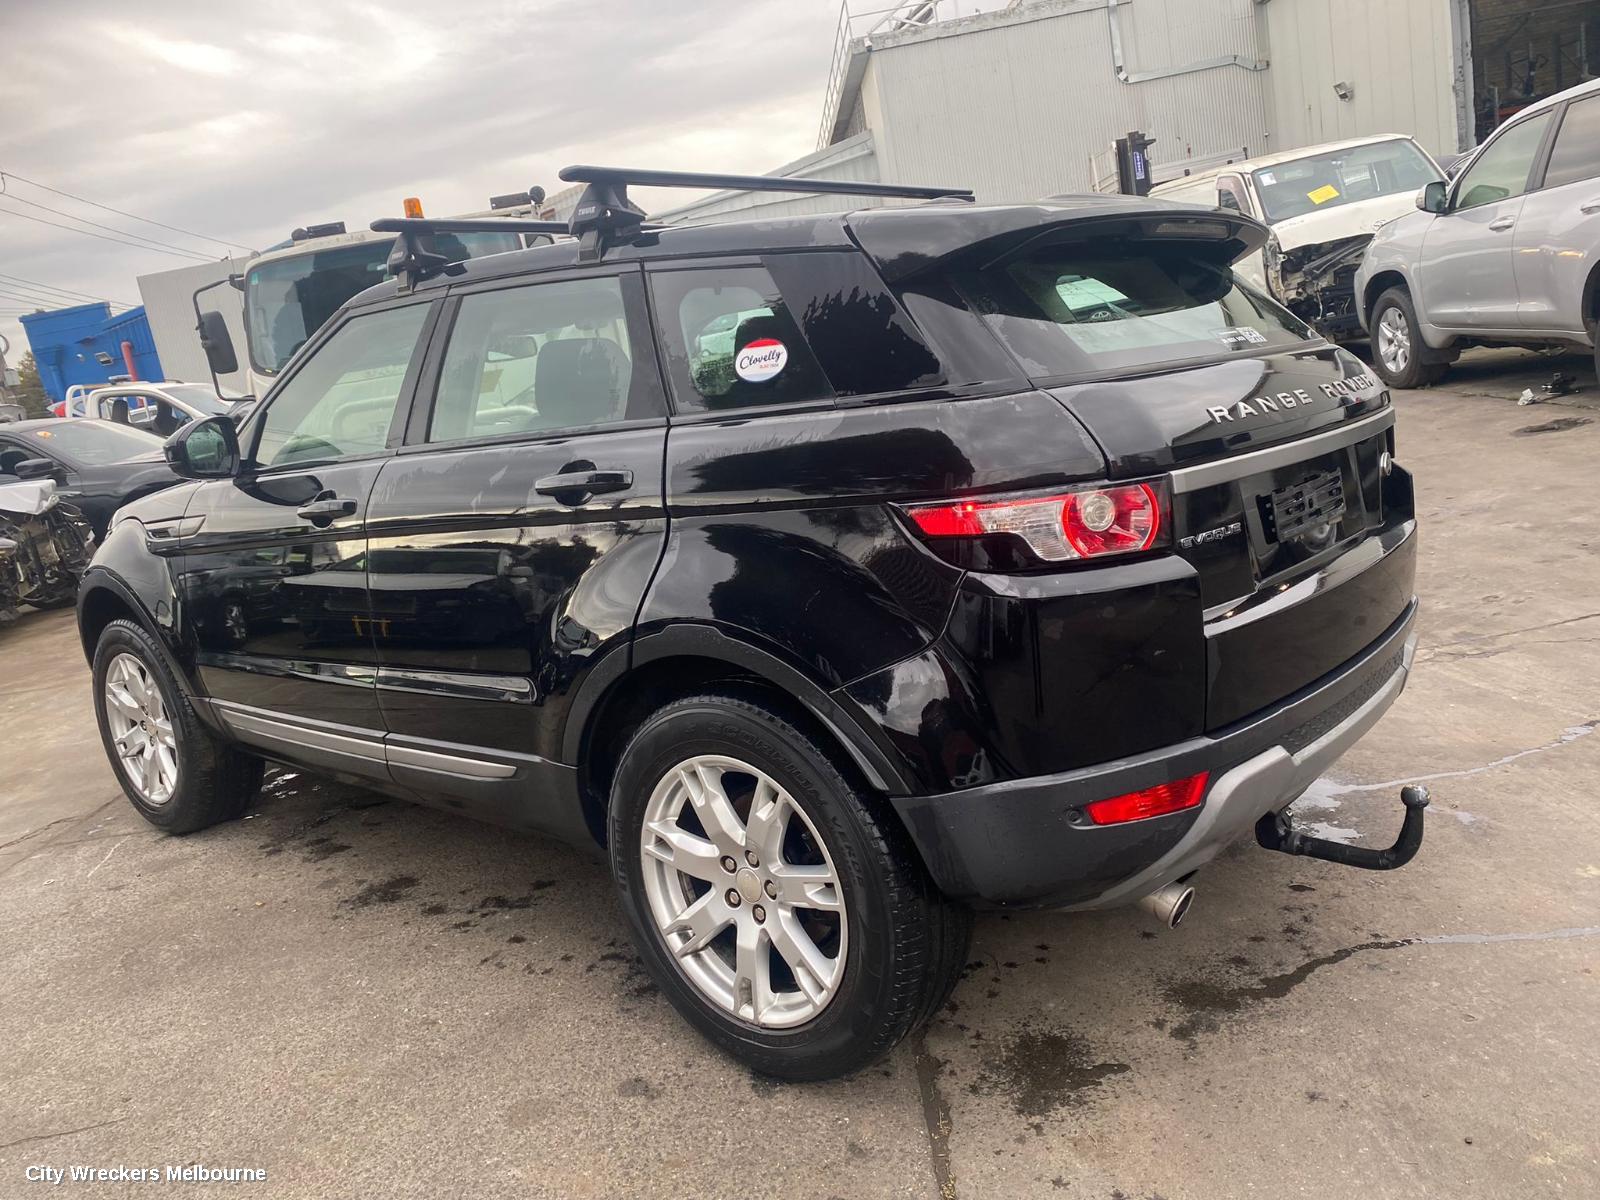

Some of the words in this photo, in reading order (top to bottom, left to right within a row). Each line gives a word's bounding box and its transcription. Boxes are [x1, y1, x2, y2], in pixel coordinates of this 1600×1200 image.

[740, 349, 785, 370] Clovelly
[1206, 389, 1313, 424] RANGE
[1319, 373, 1376, 399] ROVER
[1180, 521, 1242, 549] EVOQUE
